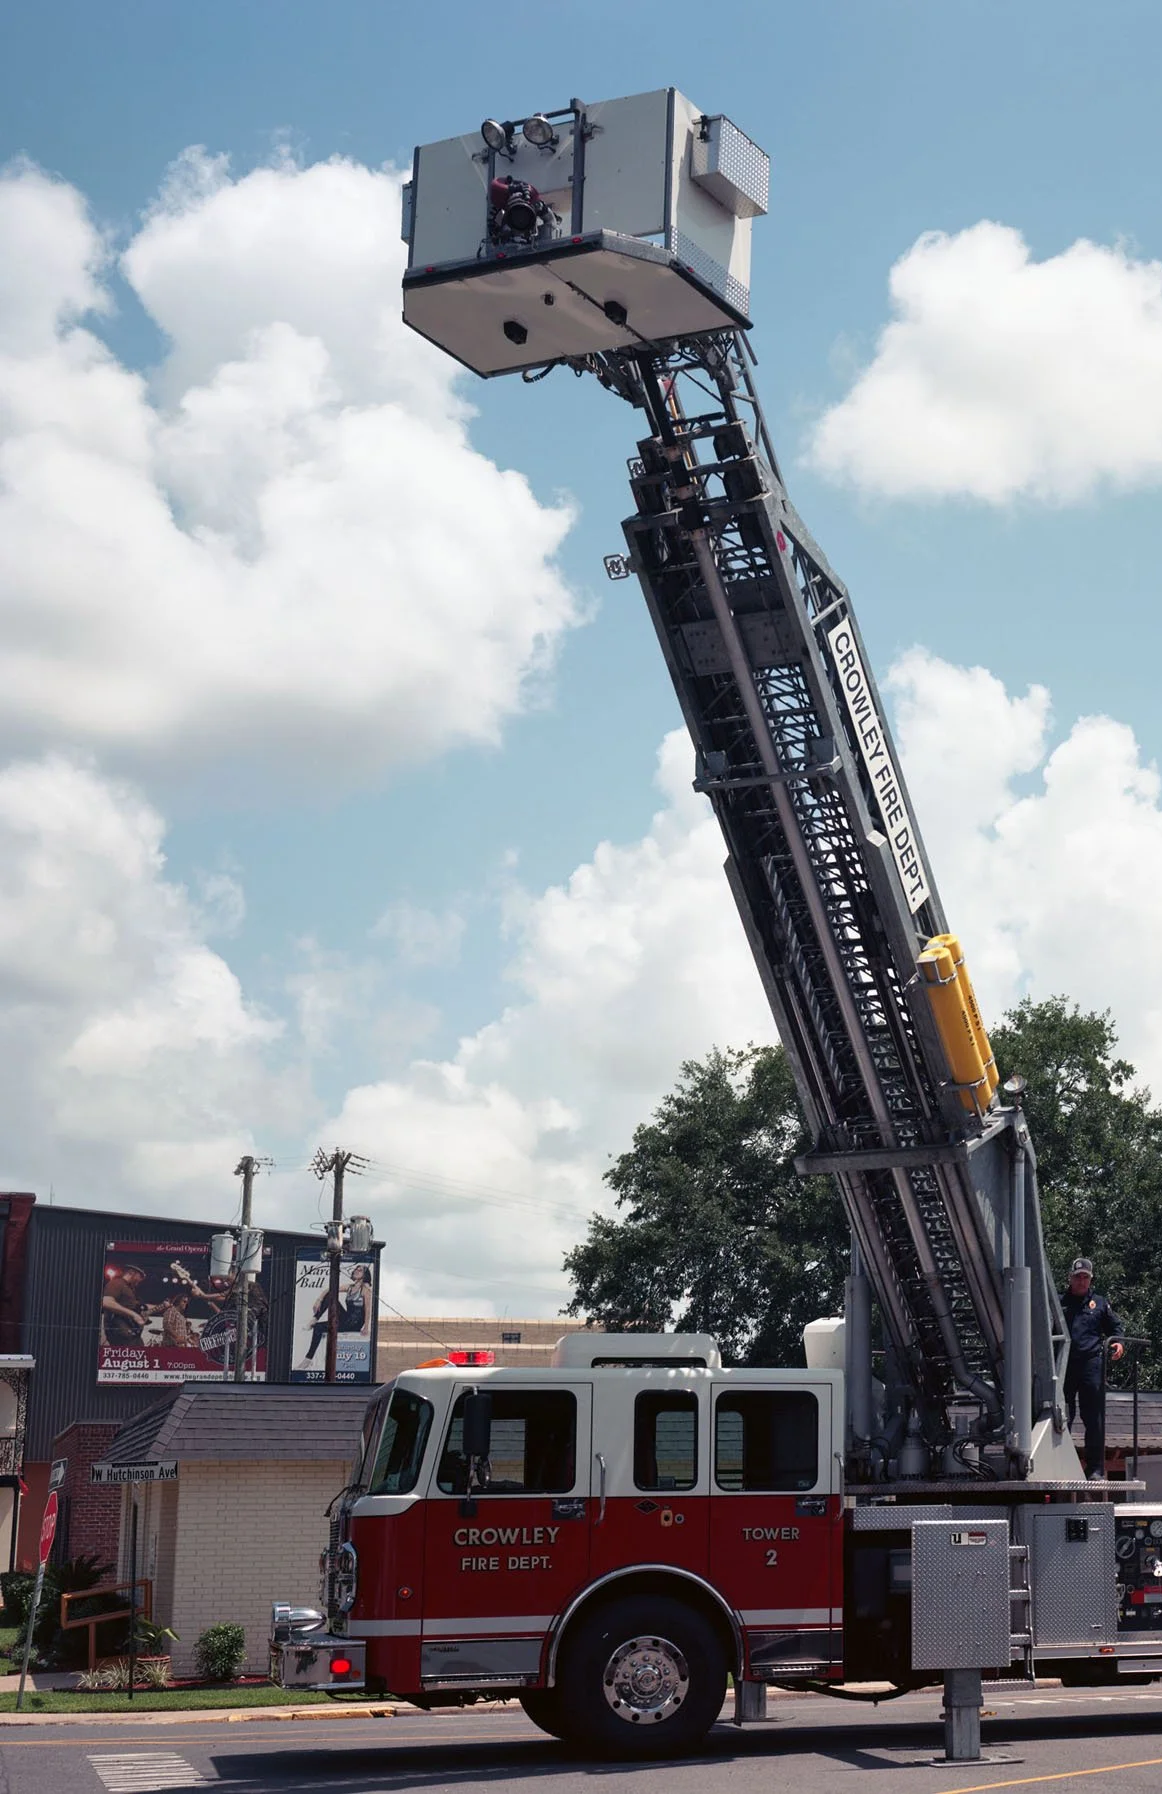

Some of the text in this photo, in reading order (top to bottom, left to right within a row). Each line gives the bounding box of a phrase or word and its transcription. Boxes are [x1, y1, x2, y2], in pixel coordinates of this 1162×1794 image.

[835, 632, 925, 903] CROWLEY FIRE DEPT.
[300, 1278, 325, 1289] Ball
[103, 1347, 147, 1360] Friday,
[336, 1352, 367, 1362] uly 19
[102, 1358, 196, 1371] August 1 7:00pm
[306, 1372, 355, 1380] 337-7-0440
[95, 1467, 175, 1480] W Hutchinson Ave
[41, 1513, 57, 1541] STOP
[454, 1527, 561, 1546] CROWLEY
[742, 1527, 800, 1541] TOWER
[461, 1555, 553, 1571] FIRE DEPT.
[766, 1549, 778, 1566] 2
